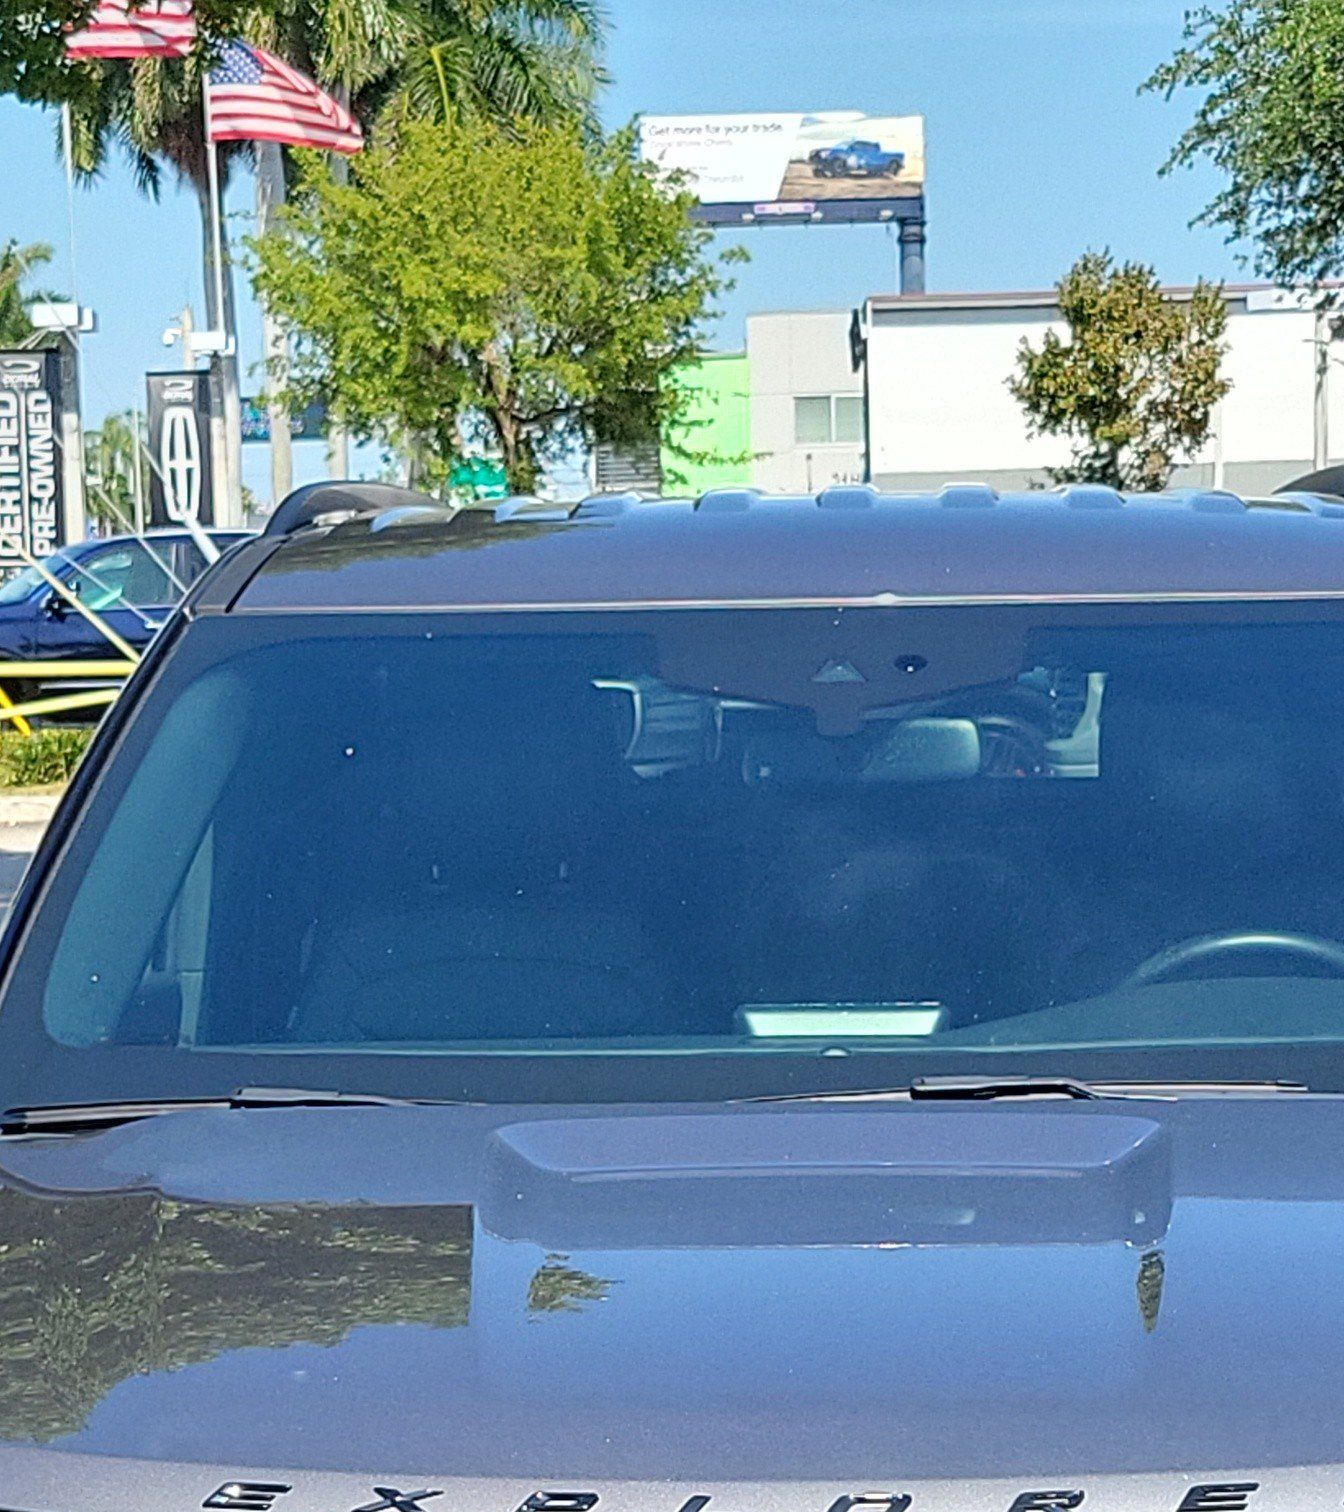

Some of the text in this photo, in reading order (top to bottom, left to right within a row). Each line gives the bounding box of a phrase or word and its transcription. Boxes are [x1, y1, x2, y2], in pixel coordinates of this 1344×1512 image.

[649, 125, 669, 136] Get
[704, 124, 720, 134] for
[723, 125, 749, 136] your
[26, 389, 56, 557] PRE-OWNED
